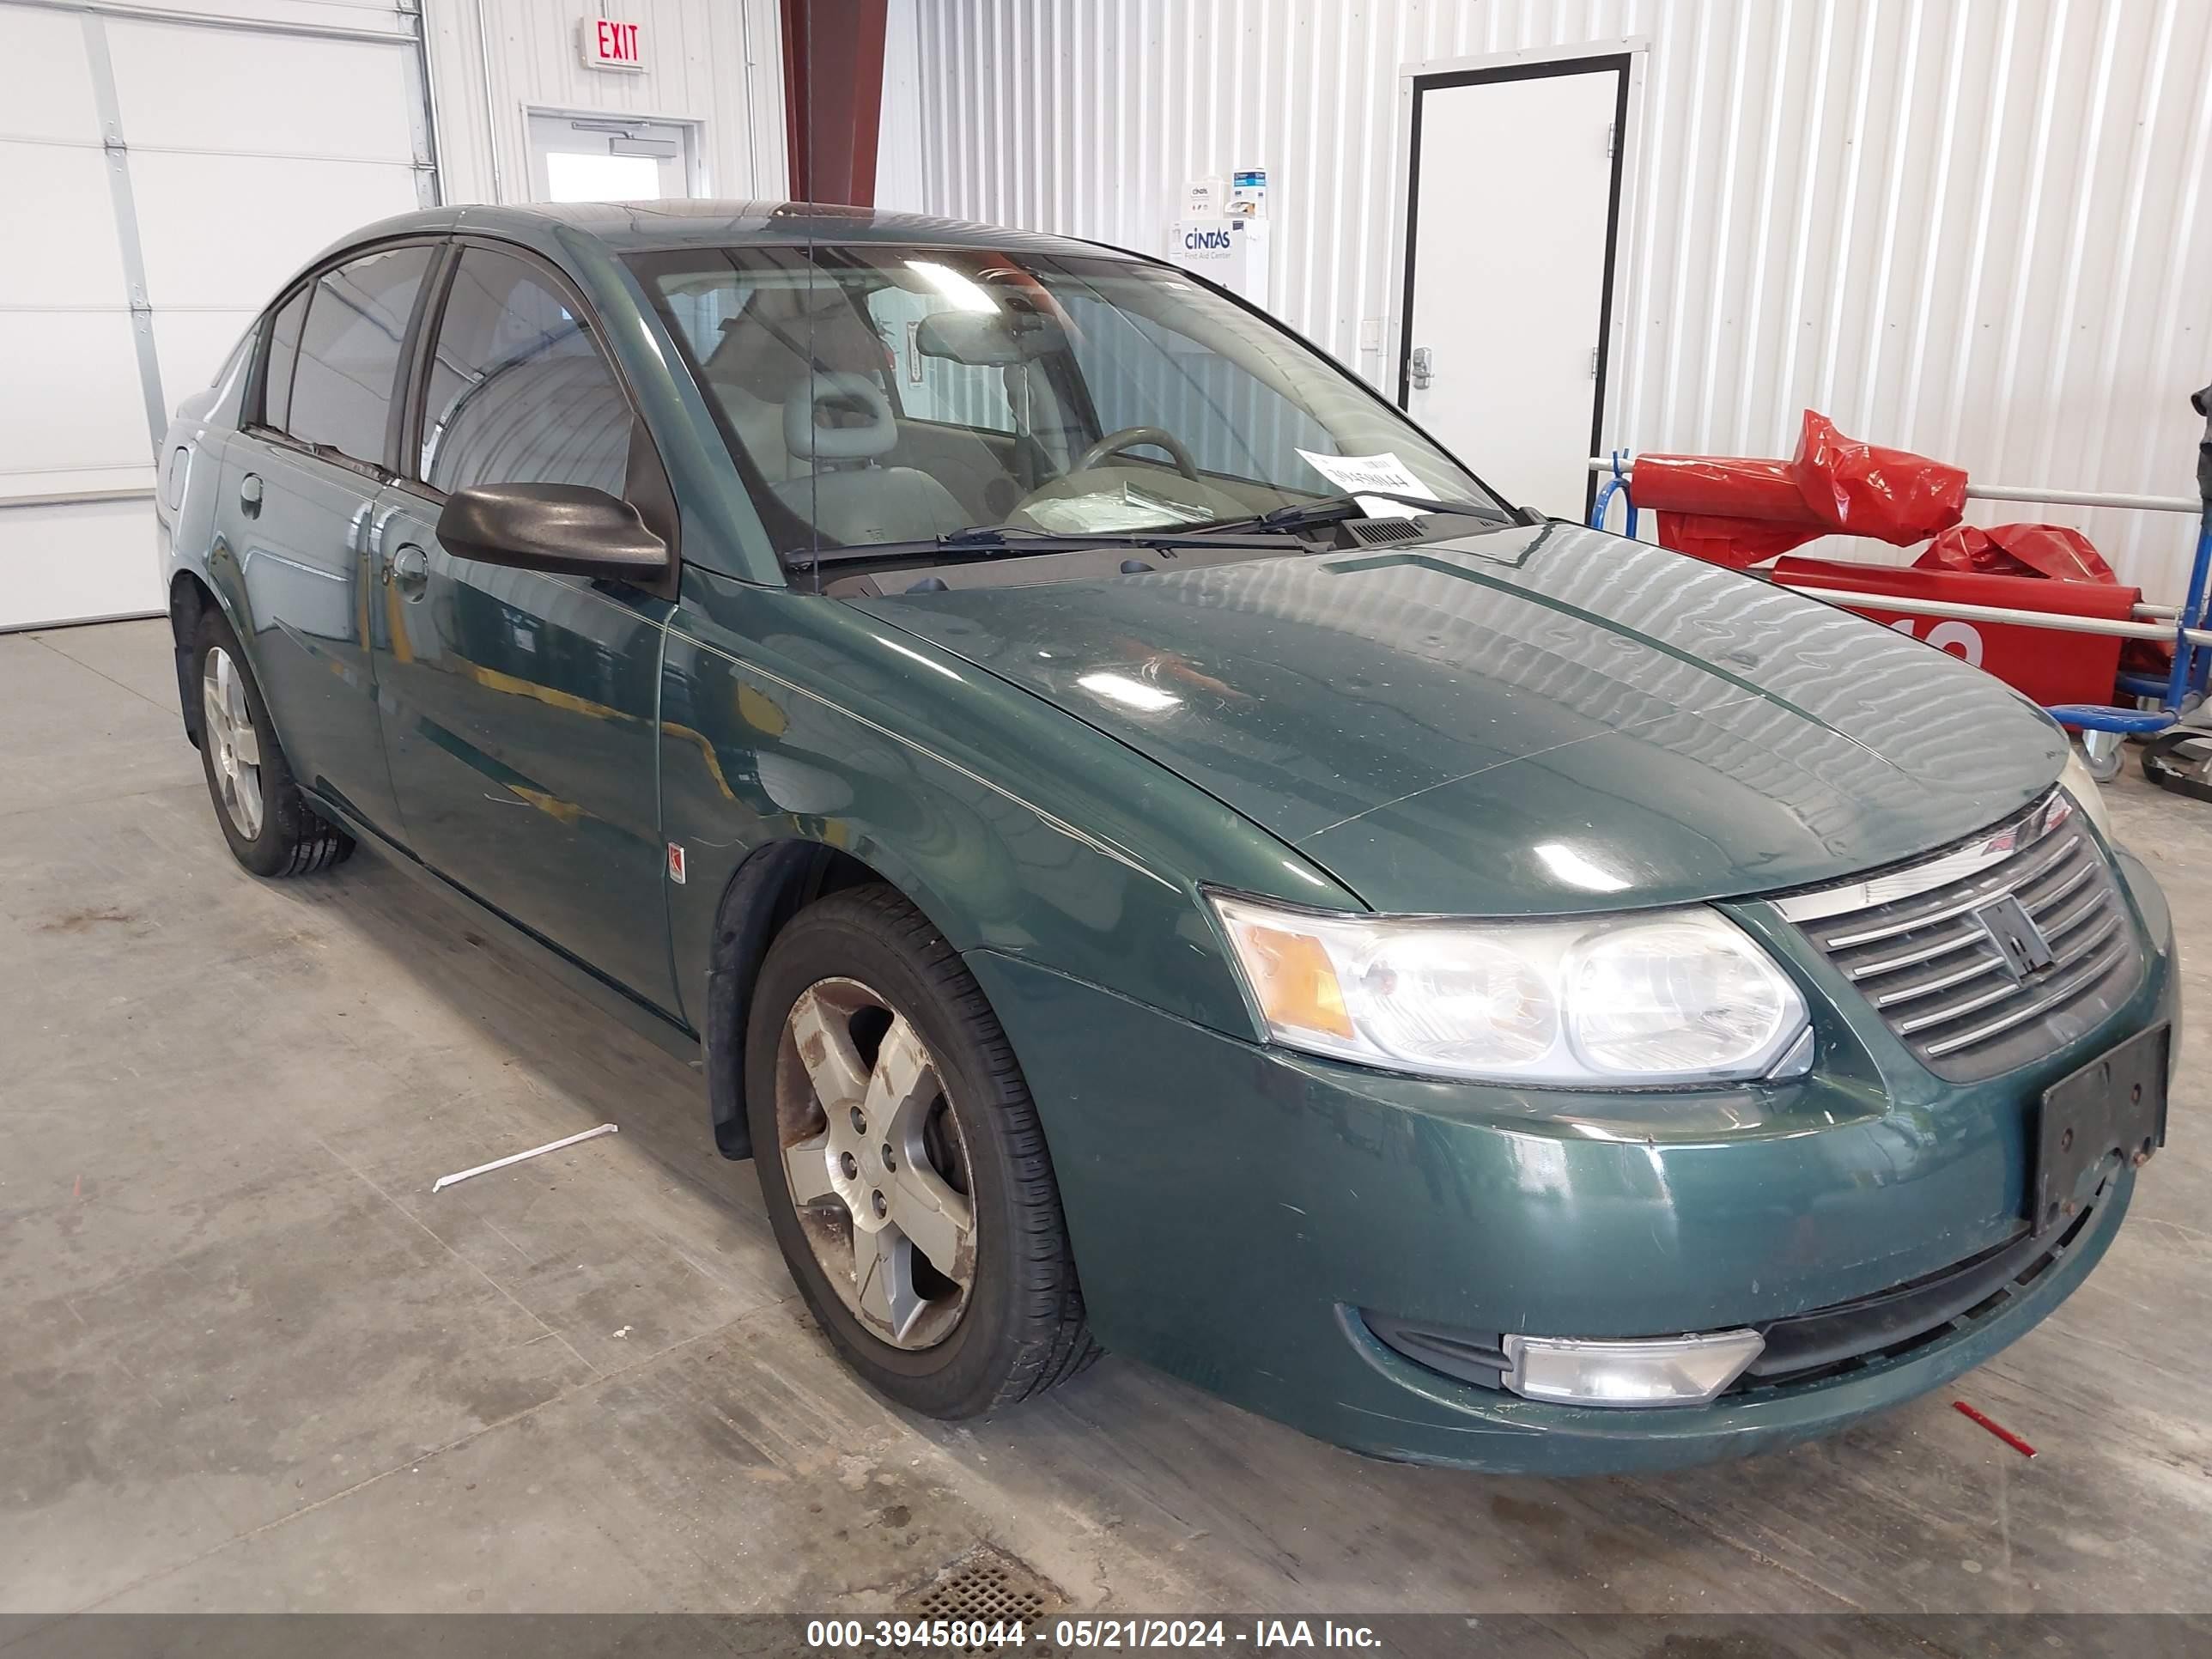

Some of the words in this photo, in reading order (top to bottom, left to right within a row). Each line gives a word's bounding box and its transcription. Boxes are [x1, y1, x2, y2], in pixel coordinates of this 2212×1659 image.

[598, 21, 638, 61] EXIT
[1185, 227, 1231, 249] CINTAS
[1211, 251, 1231, 259] Center
